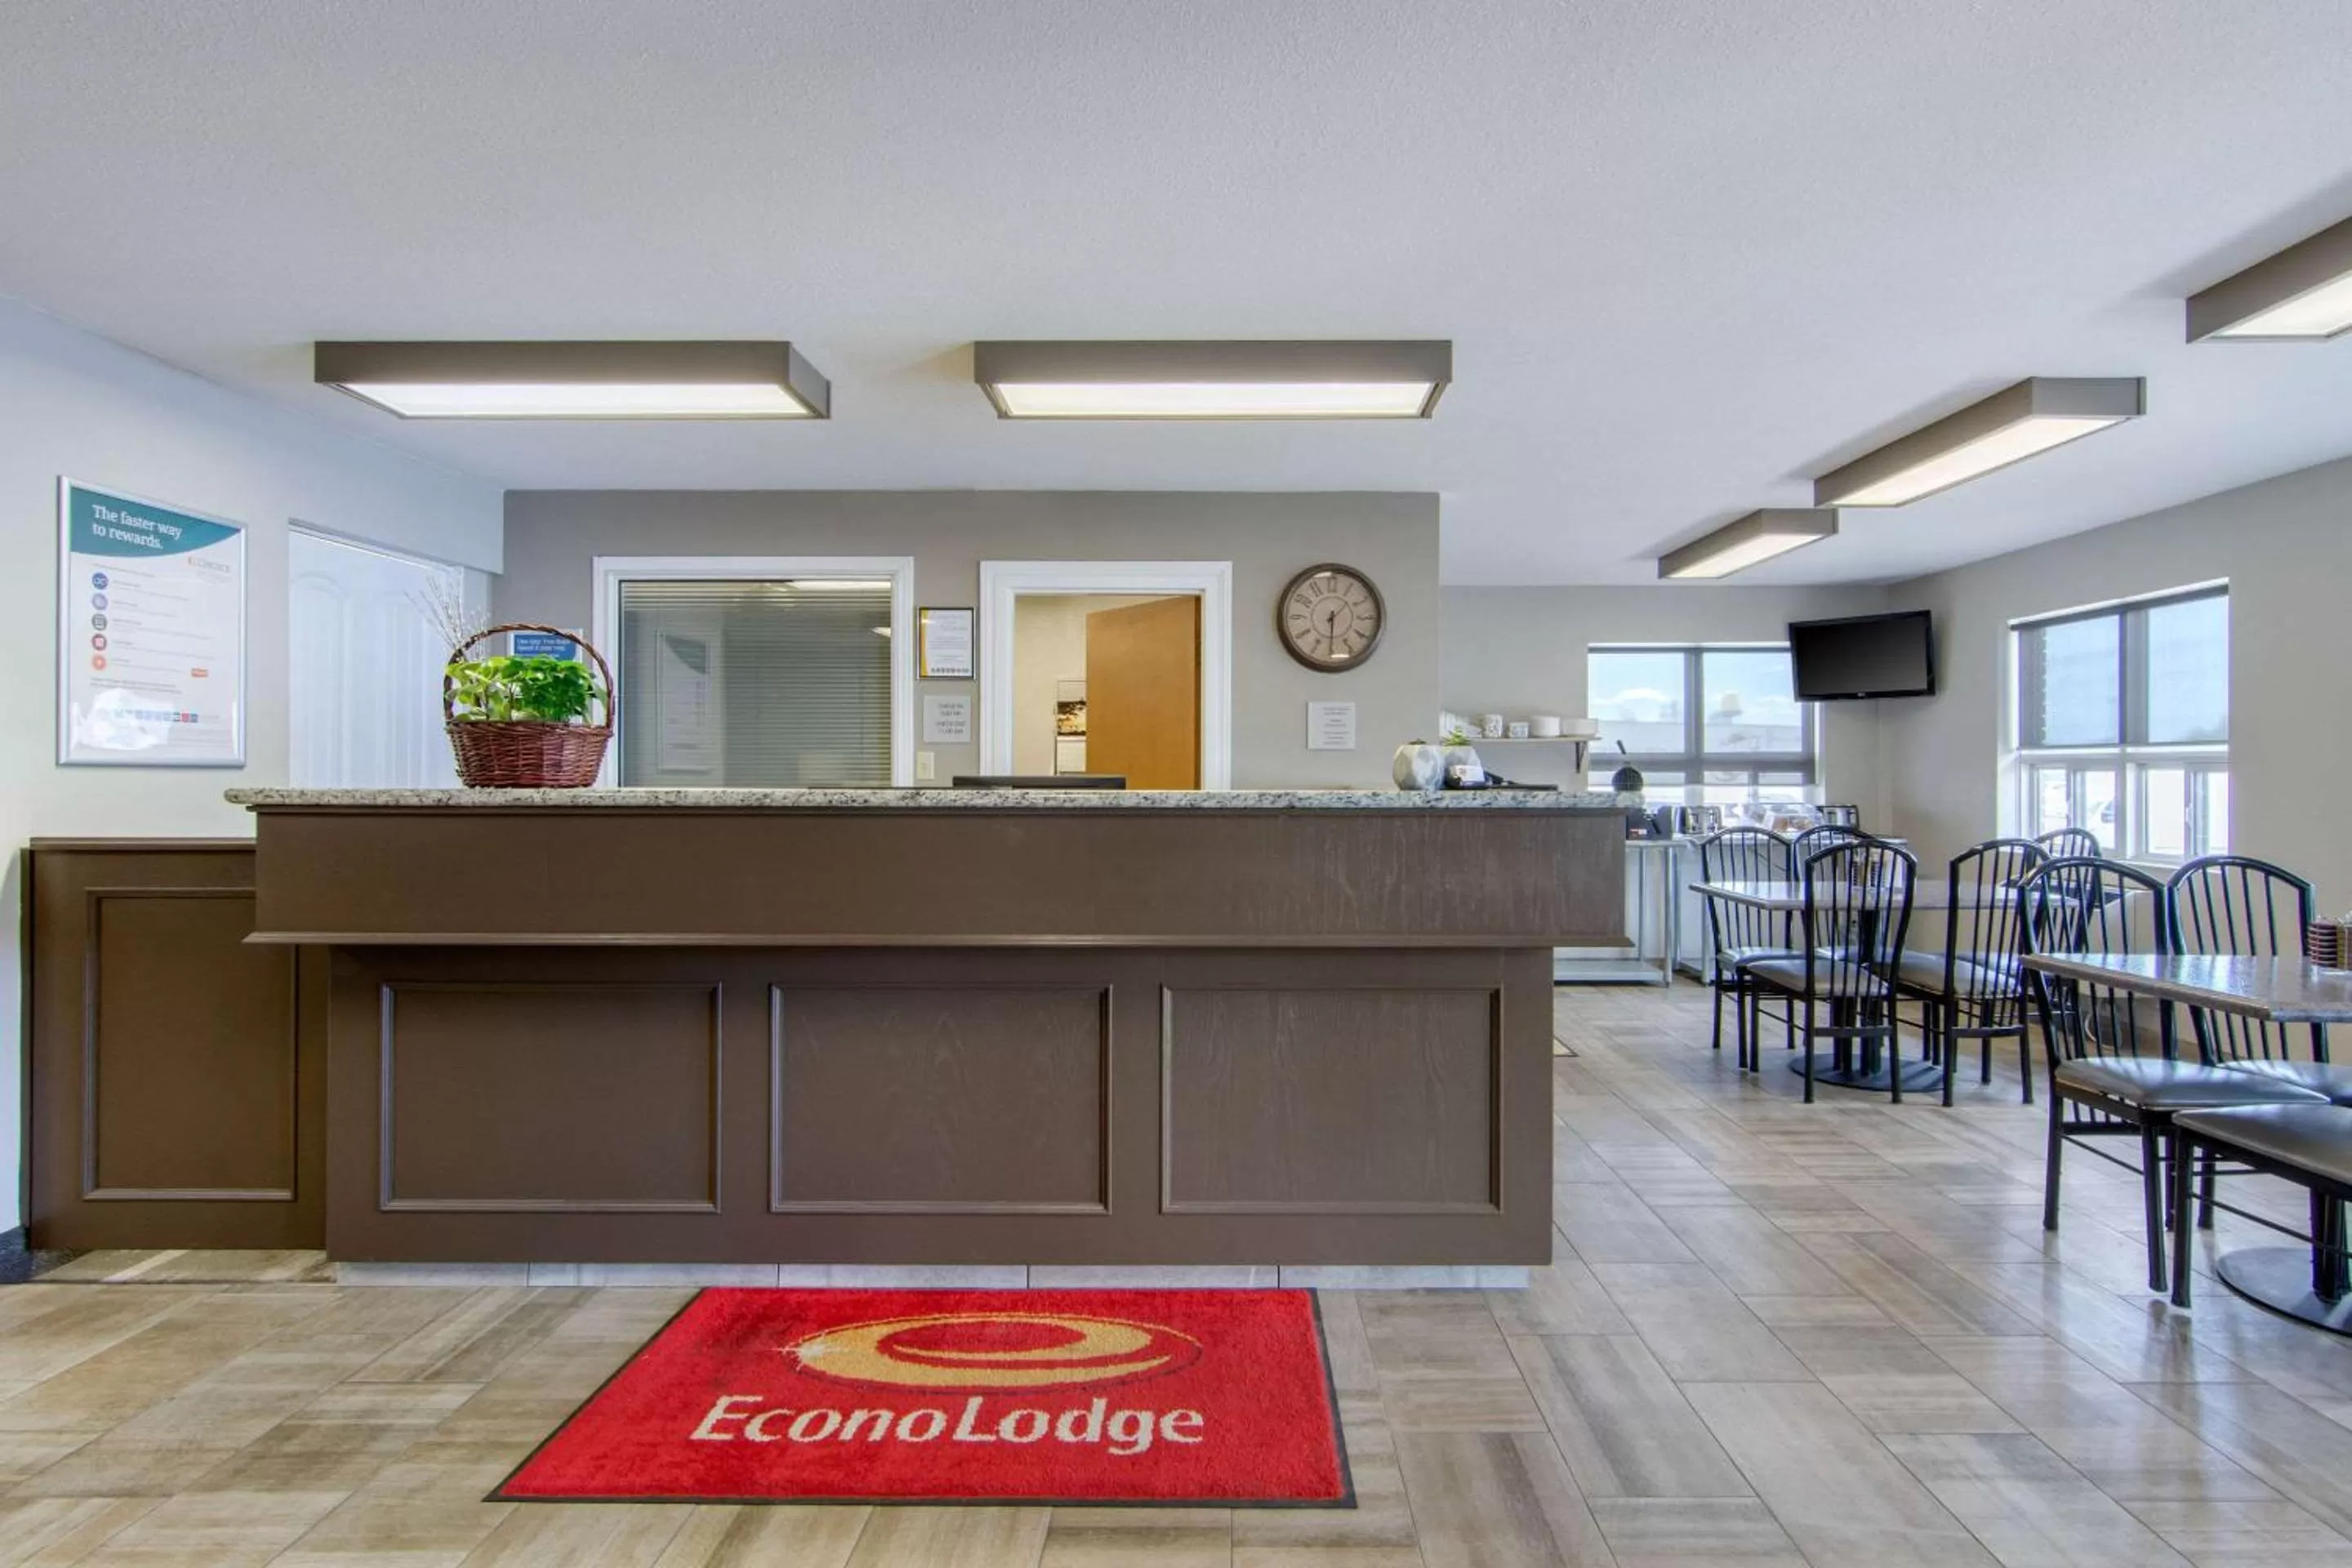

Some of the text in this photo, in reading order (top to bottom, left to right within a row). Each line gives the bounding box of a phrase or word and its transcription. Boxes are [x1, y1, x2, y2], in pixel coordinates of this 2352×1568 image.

[91, 504, 183, 540] The faster way
[91, 523, 163, 550] to rewards.
[689, 1395, 1204, 1455] EconoLodge
